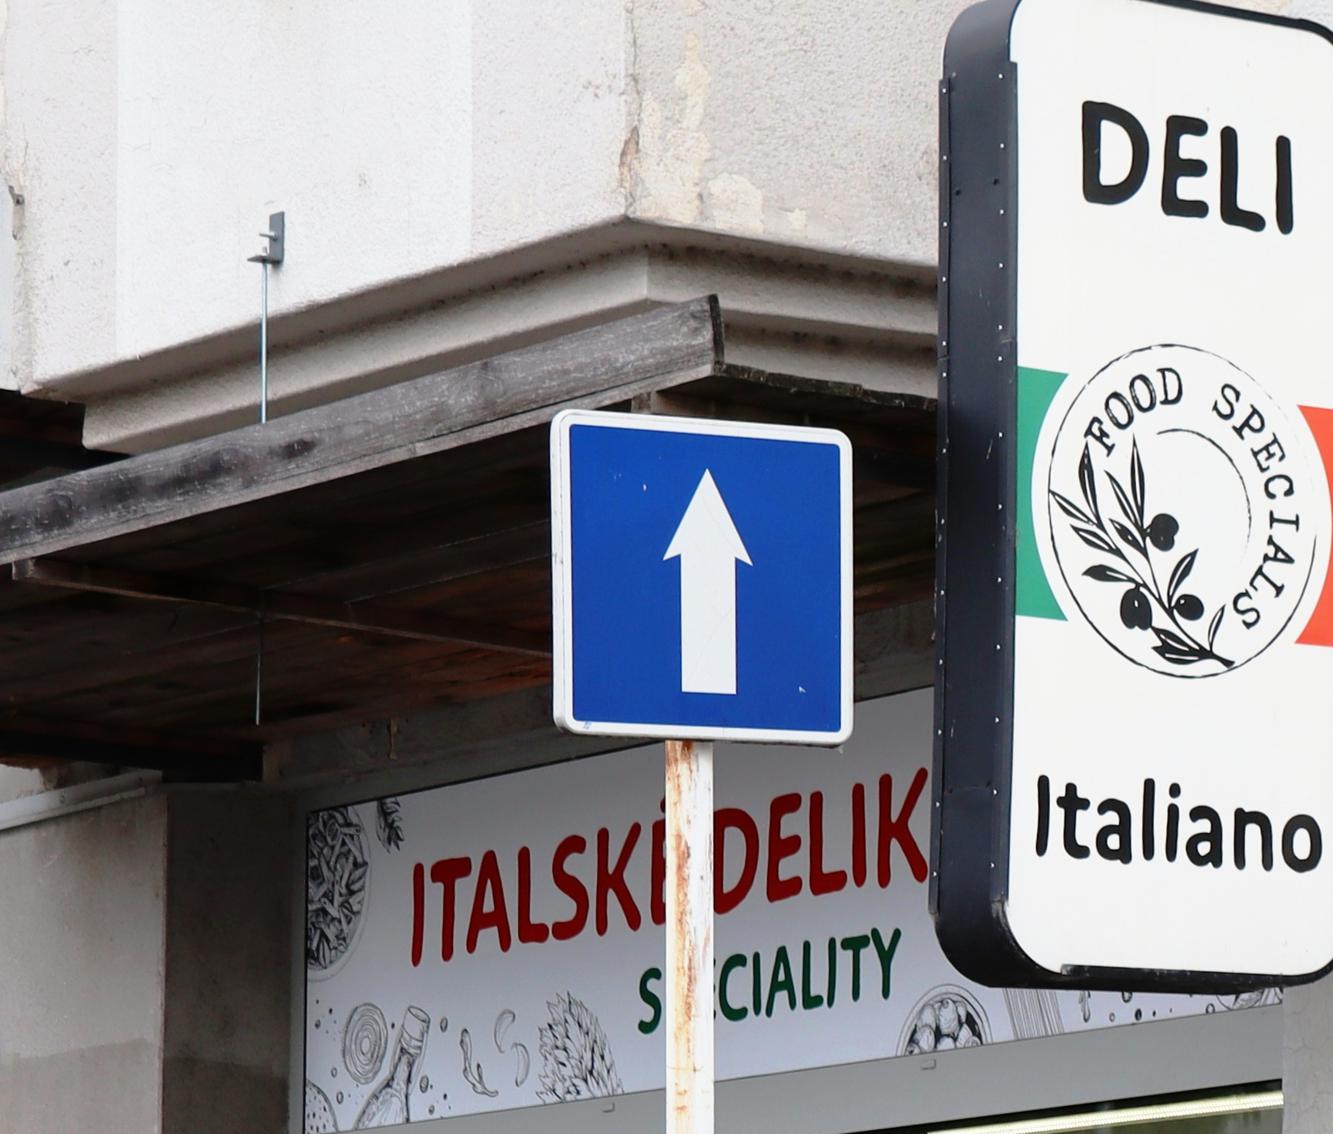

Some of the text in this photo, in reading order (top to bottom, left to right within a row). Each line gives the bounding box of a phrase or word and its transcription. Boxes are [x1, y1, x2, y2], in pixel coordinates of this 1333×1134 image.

[1080, 100, 1294, 236] DELI
[1085, 366, 1302, 630] FOOD SPECIALS
[1034, 773, 1323, 874] Italiano
[637, 927, 903, 1034] SCIALITY
